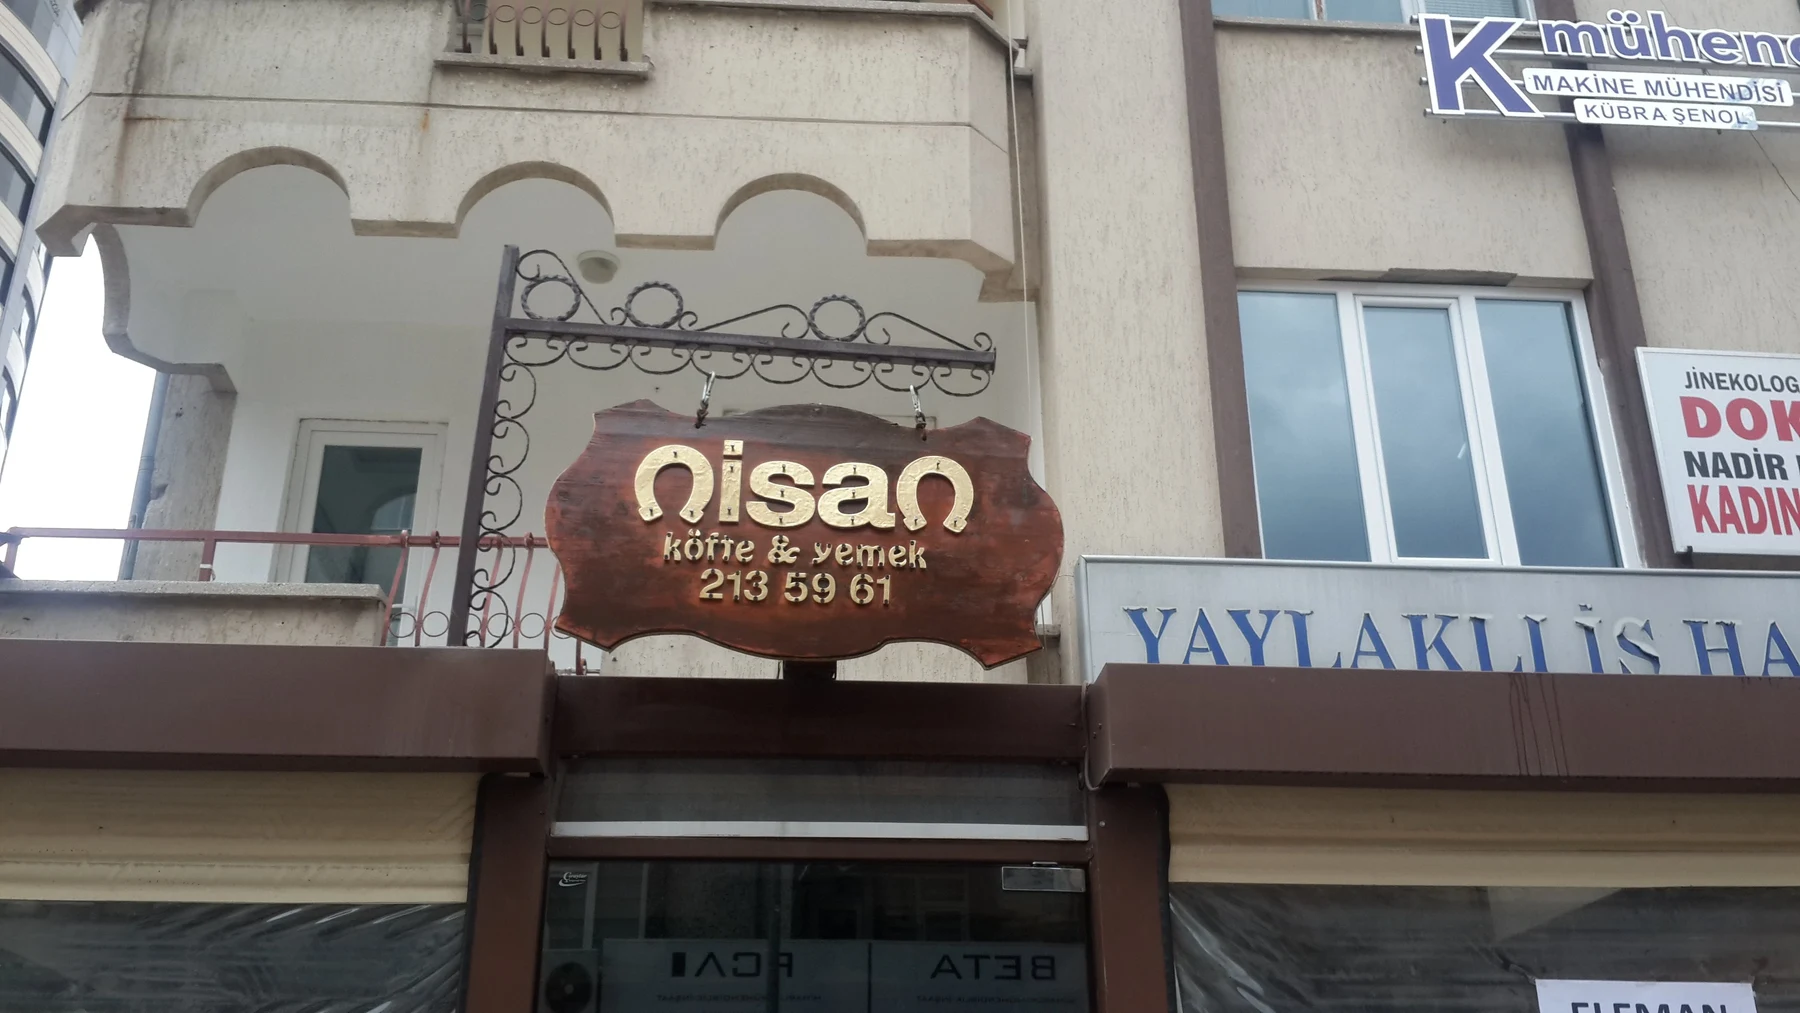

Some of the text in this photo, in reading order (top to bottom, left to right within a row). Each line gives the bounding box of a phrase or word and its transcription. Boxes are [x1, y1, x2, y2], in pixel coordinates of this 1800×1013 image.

[1419, 13, 1544, 118] K
[1532, 73, 1786, 104] MAKİNE MÜHENDİSİ
[1584, 103, 1749, 126] KÜBRA ŞENOL
[1683, 447, 1789, 481] NADİR
[634, 440, 974, 533] nisan
[663, 528, 927, 569] köfte & yemek
[699, 568, 891, 605] 213 59 61
[1121, 606, 1548, 672] YAYLAKLI
